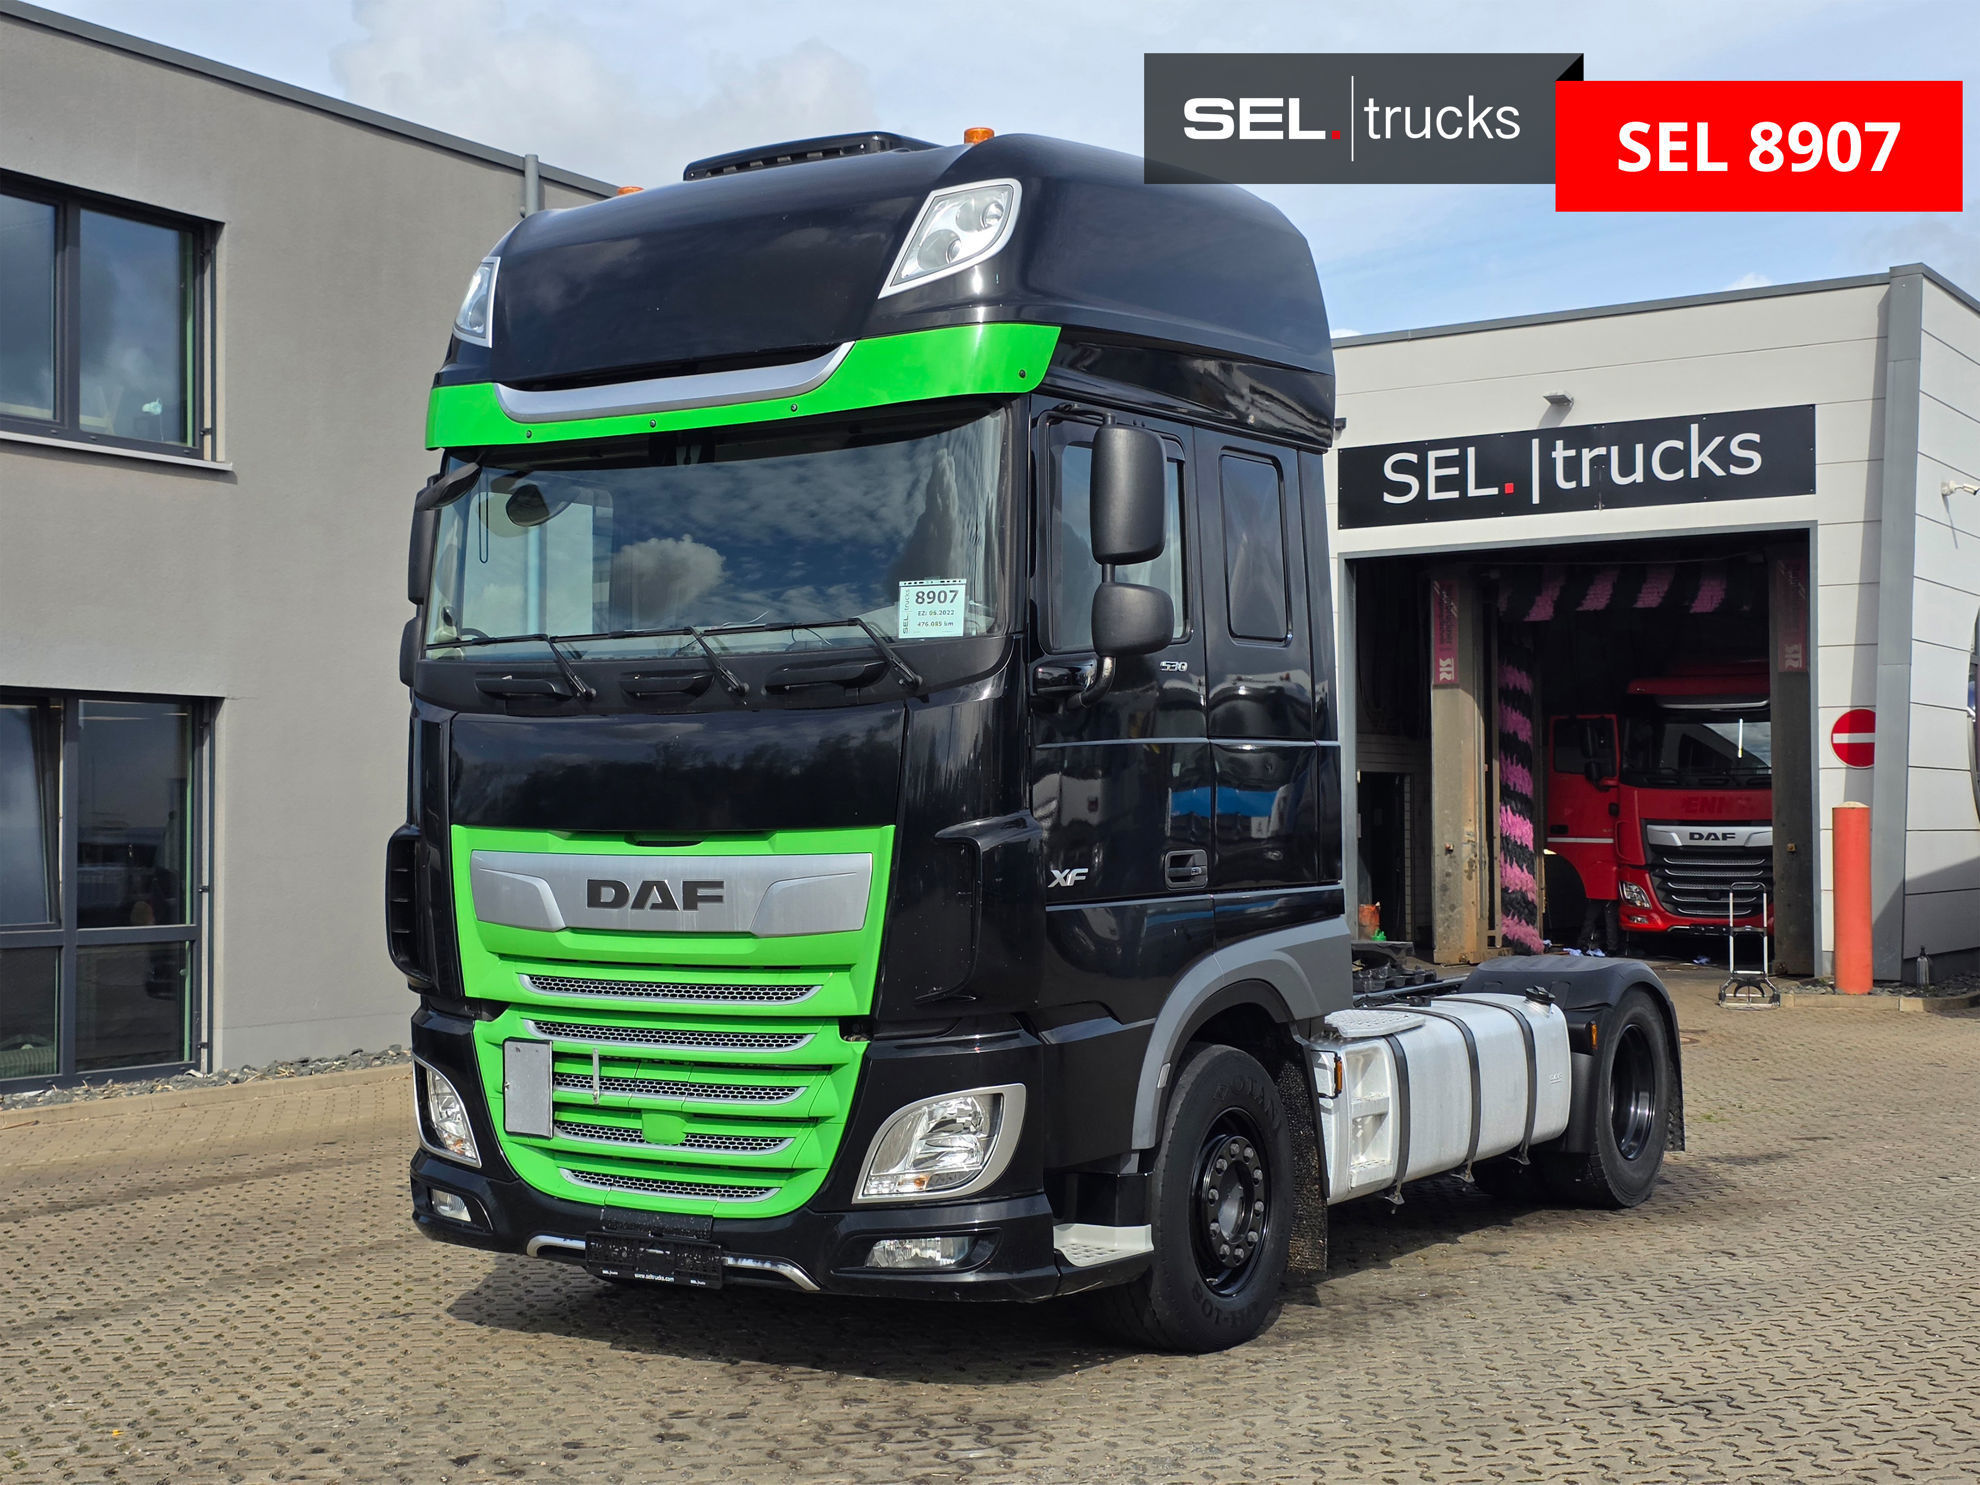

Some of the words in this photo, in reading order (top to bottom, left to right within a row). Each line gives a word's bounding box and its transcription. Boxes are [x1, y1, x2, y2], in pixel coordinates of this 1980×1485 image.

[915, 590, 959, 604] 8907
[1688, 831, 1736, 841] DAF
[1047, 867, 1089, 888] XF
[586, 878, 725, 912] DAF
